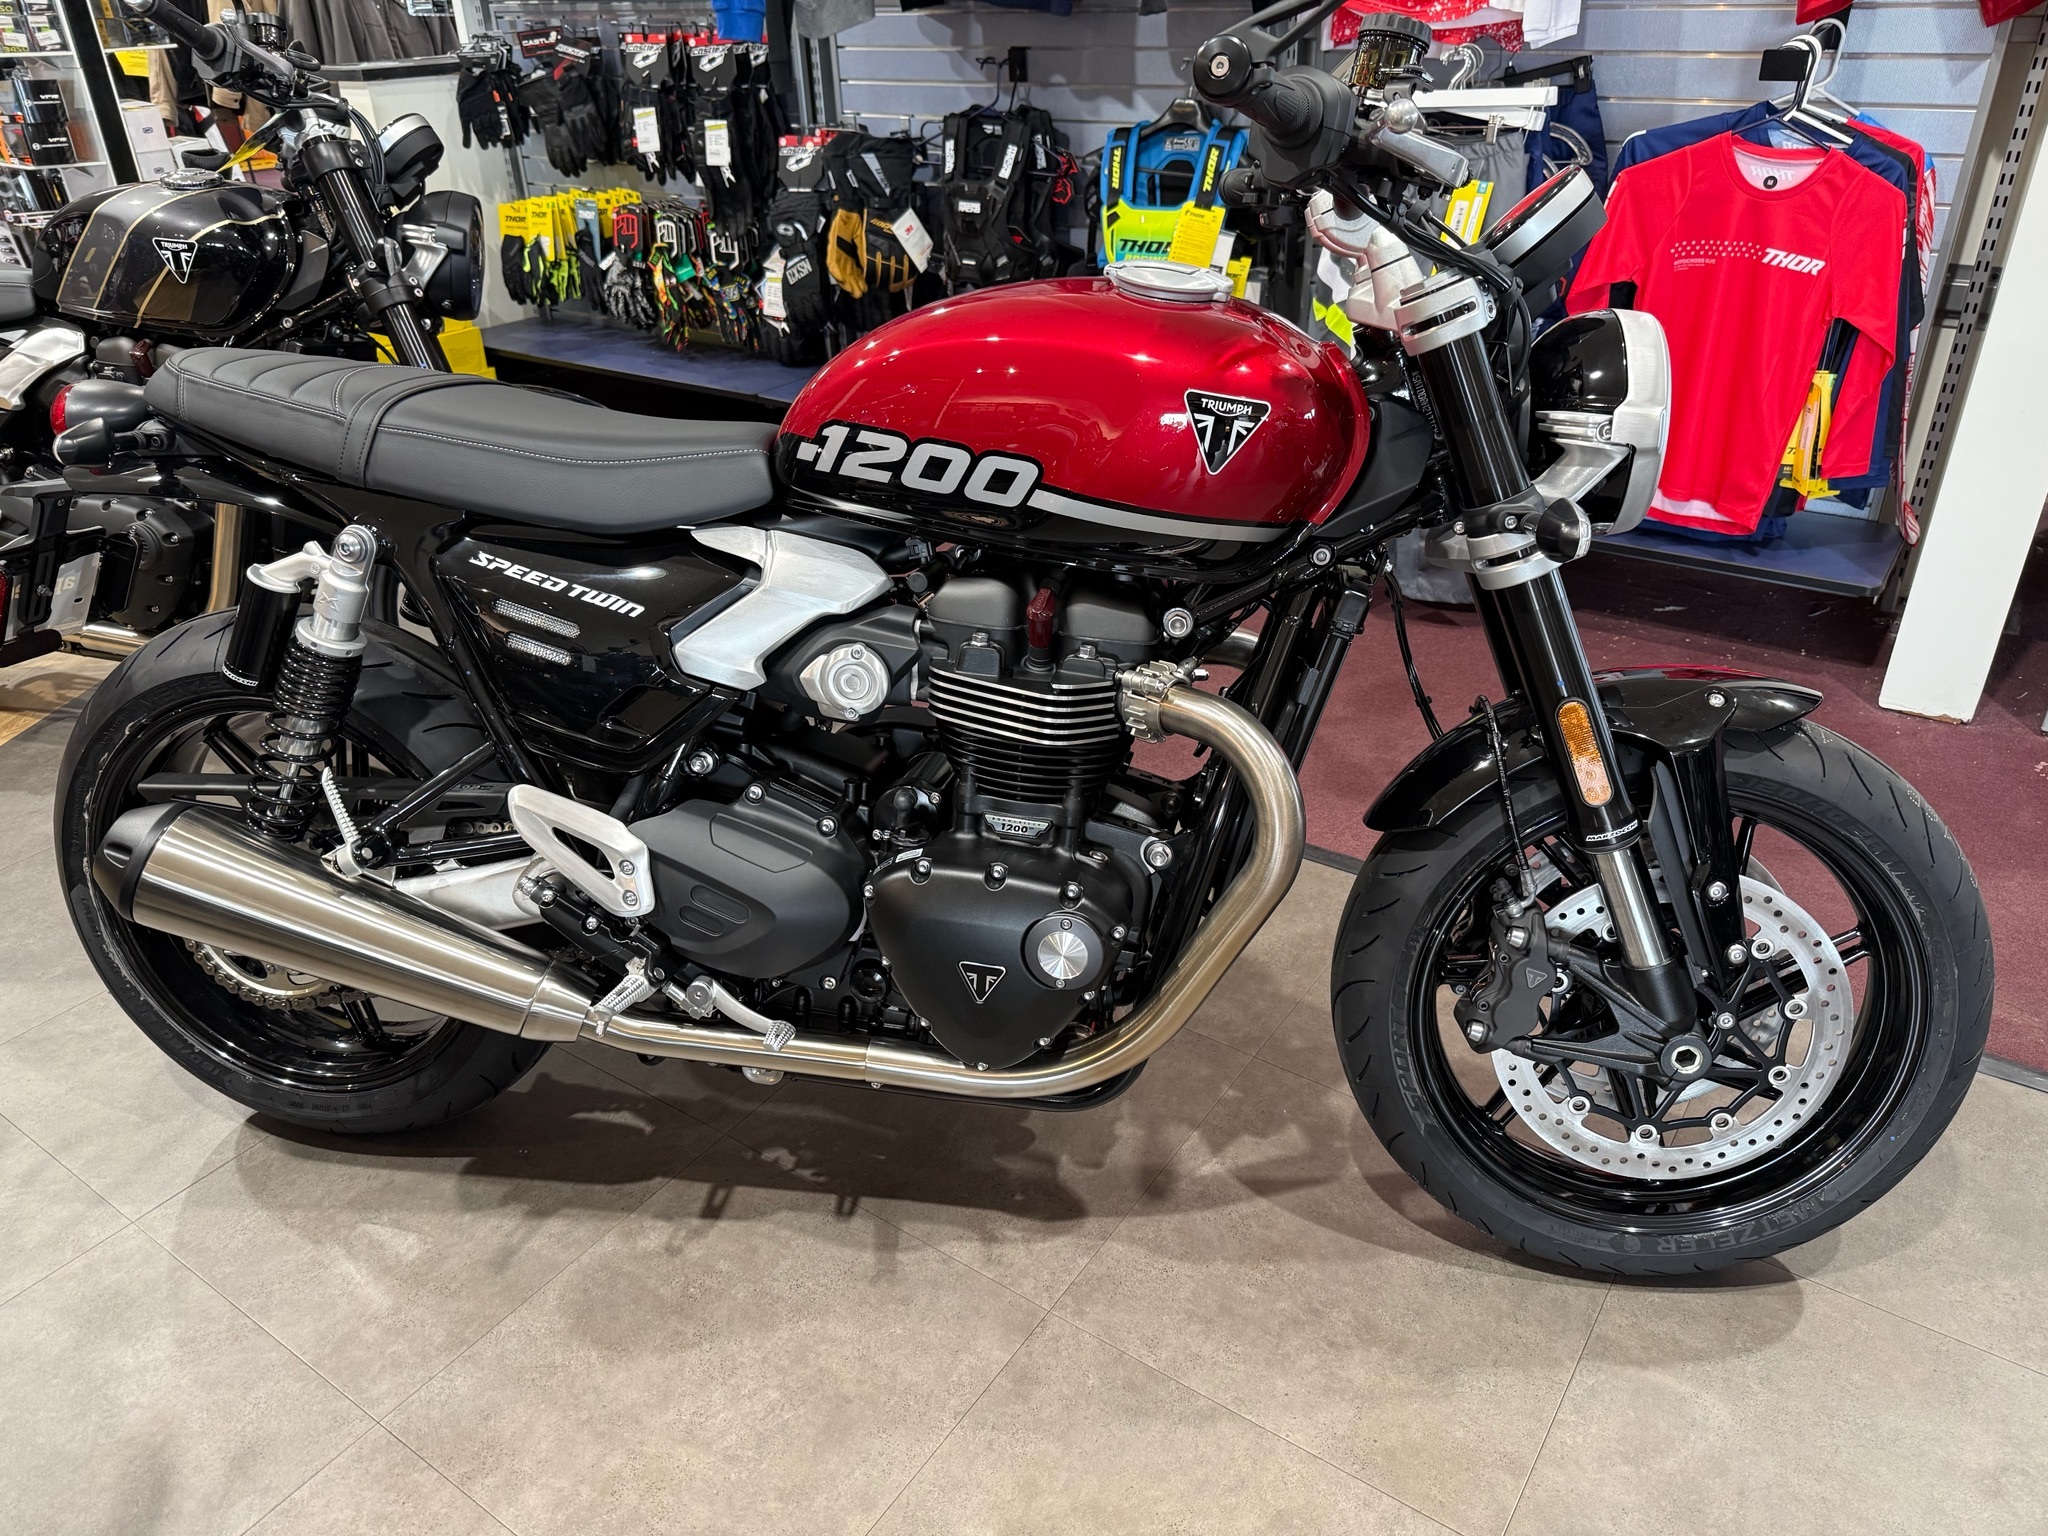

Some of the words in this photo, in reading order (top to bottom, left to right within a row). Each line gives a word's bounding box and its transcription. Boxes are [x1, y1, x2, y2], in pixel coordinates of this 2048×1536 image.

[1111, 147, 1122, 190] THOR
[1203, 147, 1220, 192] THOR
[504, 215, 526, 223] THOR
[531, 211, 548, 219] THOR
[577, 210, 595, 220] THOR
[160, 241, 188, 251] TRIUMPH
[1761, 247, 1827, 276] THOR
[1201, 398, 1253, 417] TRIUMPH
[469, 551, 569, 592] SPEED
[567, 584, 645, 618] TWIN
[1001, 823, 1029, 833] 1200
[1586, 820, 1638, 841] MARZOCCHI
[1656, 1198, 1826, 1254] METZELER
